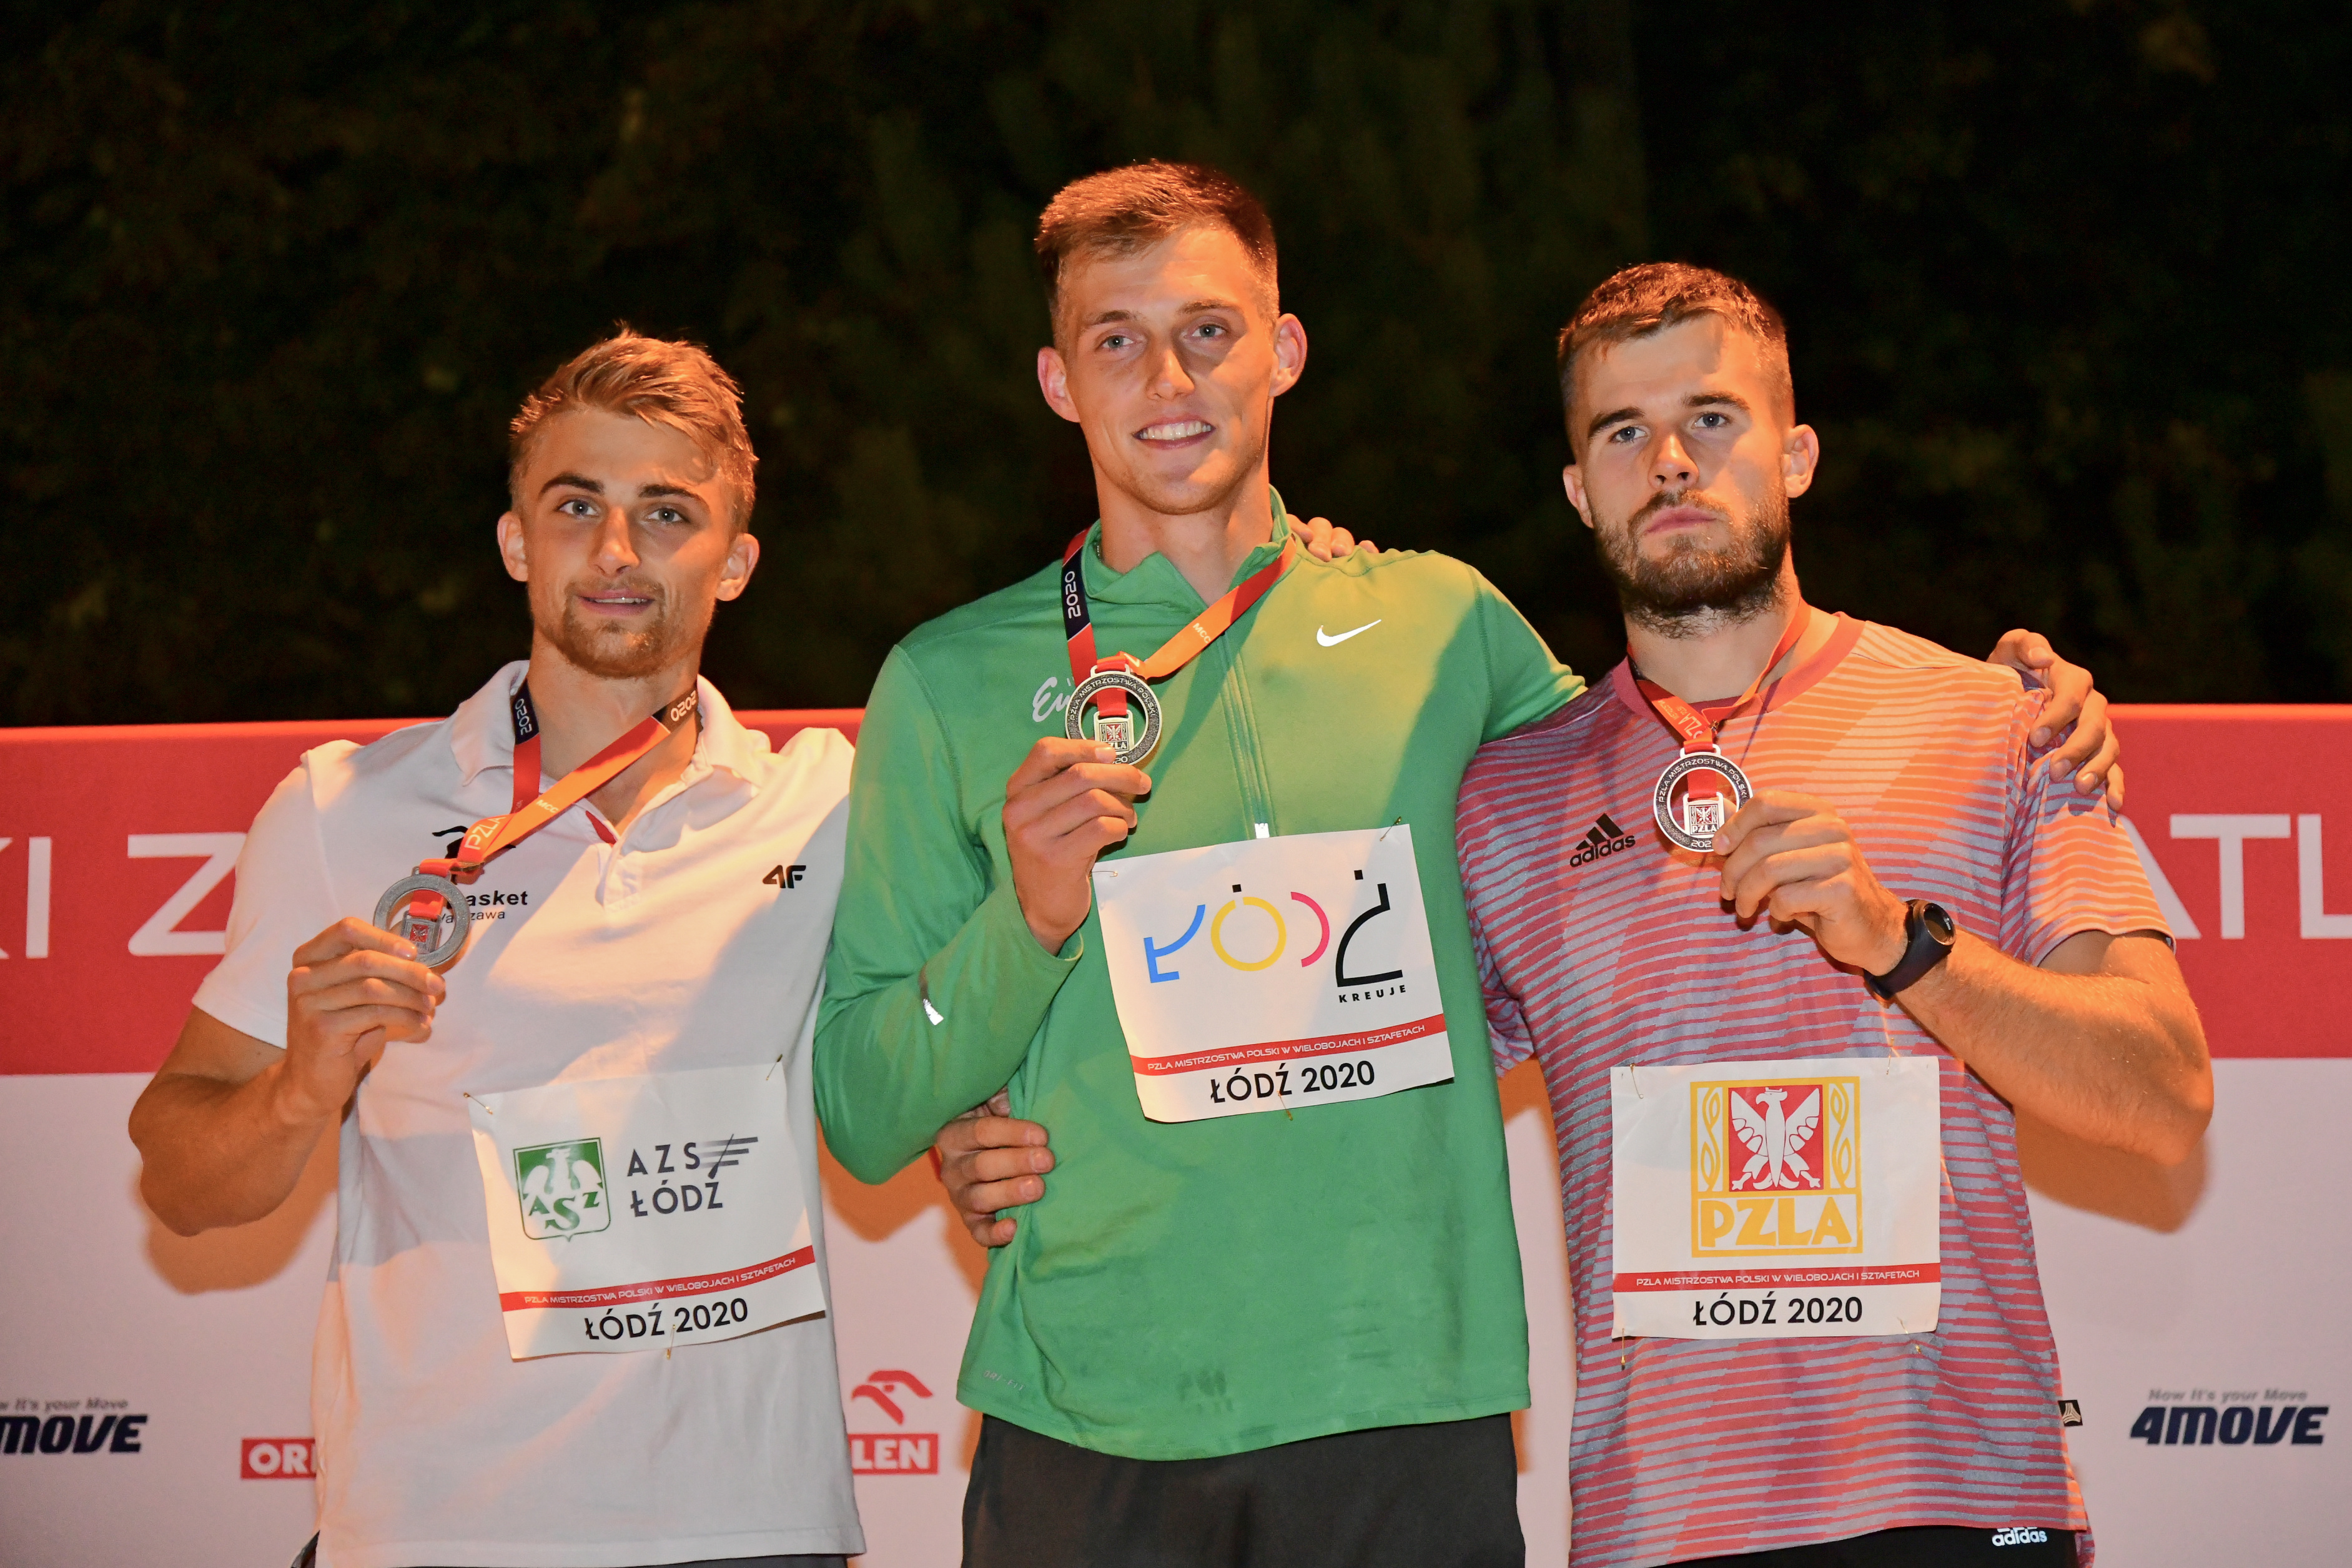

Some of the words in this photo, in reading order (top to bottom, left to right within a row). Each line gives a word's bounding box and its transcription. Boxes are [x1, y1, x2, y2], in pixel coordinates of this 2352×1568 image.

[1064, 571, 1081, 619] 2020
[1192, 623, 1211, 643] MCC
[670, 690, 697, 722] 2020
[1070, 699, 1080, 720] PZLA
[1079, 676, 1137, 698] MISTRZOSTWA
[1137, 688, 1155, 716] POLSKI
[515, 698, 532, 736] 2020
[1658, 781, 1671, 802] PZLA
[1669, 758, 1727, 779] MISTRZOSTWA
[1728, 769, 1747, 798] POLSKI
[535, 799, 559, 814] MCC
[464, 816, 506, 851] PZLA
[1691, 839, 1712, 847] 202
[1692, 823, 1717, 834] PZLA
[1569, 835, 1636, 868] adidas
[762, 865, 807, 889] 4F
[0, 836, 52, 959] I
[447, 890, 528, 909] asket
[1339, 985, 1406, 1003] KREUJE
[1148, 1061, 1173, 1070] PZLA
[1174, 1052, 1245, 1067] MISTRZOSTWA
[1247, 1047, 1280, 1058] POLSKI
[1281, 1046, 1291, 1055] W
[1292, 1037, 1361, 1053] WIELOBOJACH
[1367, 1025, 1426, 1044] SZTAFETACH
[1210, 1063, 1292, 1103] ŁÓDŹ
[1301, 1060, 1375, 1093] 2020
[1700, 1197, 1852, 1248] PZLA
[550, 1292, 617, 1303] MISTRZOSTWA
[618, 1288, 653, 1298] POLSKI
[666, 1276, 735, 1292] WIELOBOJACH
[741, 1258, 796, 1281] SZTAFETACH
[1636, 1278, 1661, 1286] PZLA
[1663, 1275, 1733, 1286] MISTRZOSTWA
[1736, 1275, 1769, 1283] POLSKI
[1772, 1274, 1782, 1283] W
[1784, 1273, 1854, 1282] WIELOBOJACH
[1861, 1270, 1920, 1280] SZTAFETACH
[584, 1303, 665, 1340] ŁÓDŹ
[674, 1298, 748, 1333] 2020
[1693, 1291, 1777, 1326] ŁÓDŹ
[1788, 1296, 1862, 1324] 2020
[2130, 1406, 2329, 1445] 4MOVE
[851, 1439, 931, 1469] LEN
[1992, 1528, 2048, 1547] adidas
